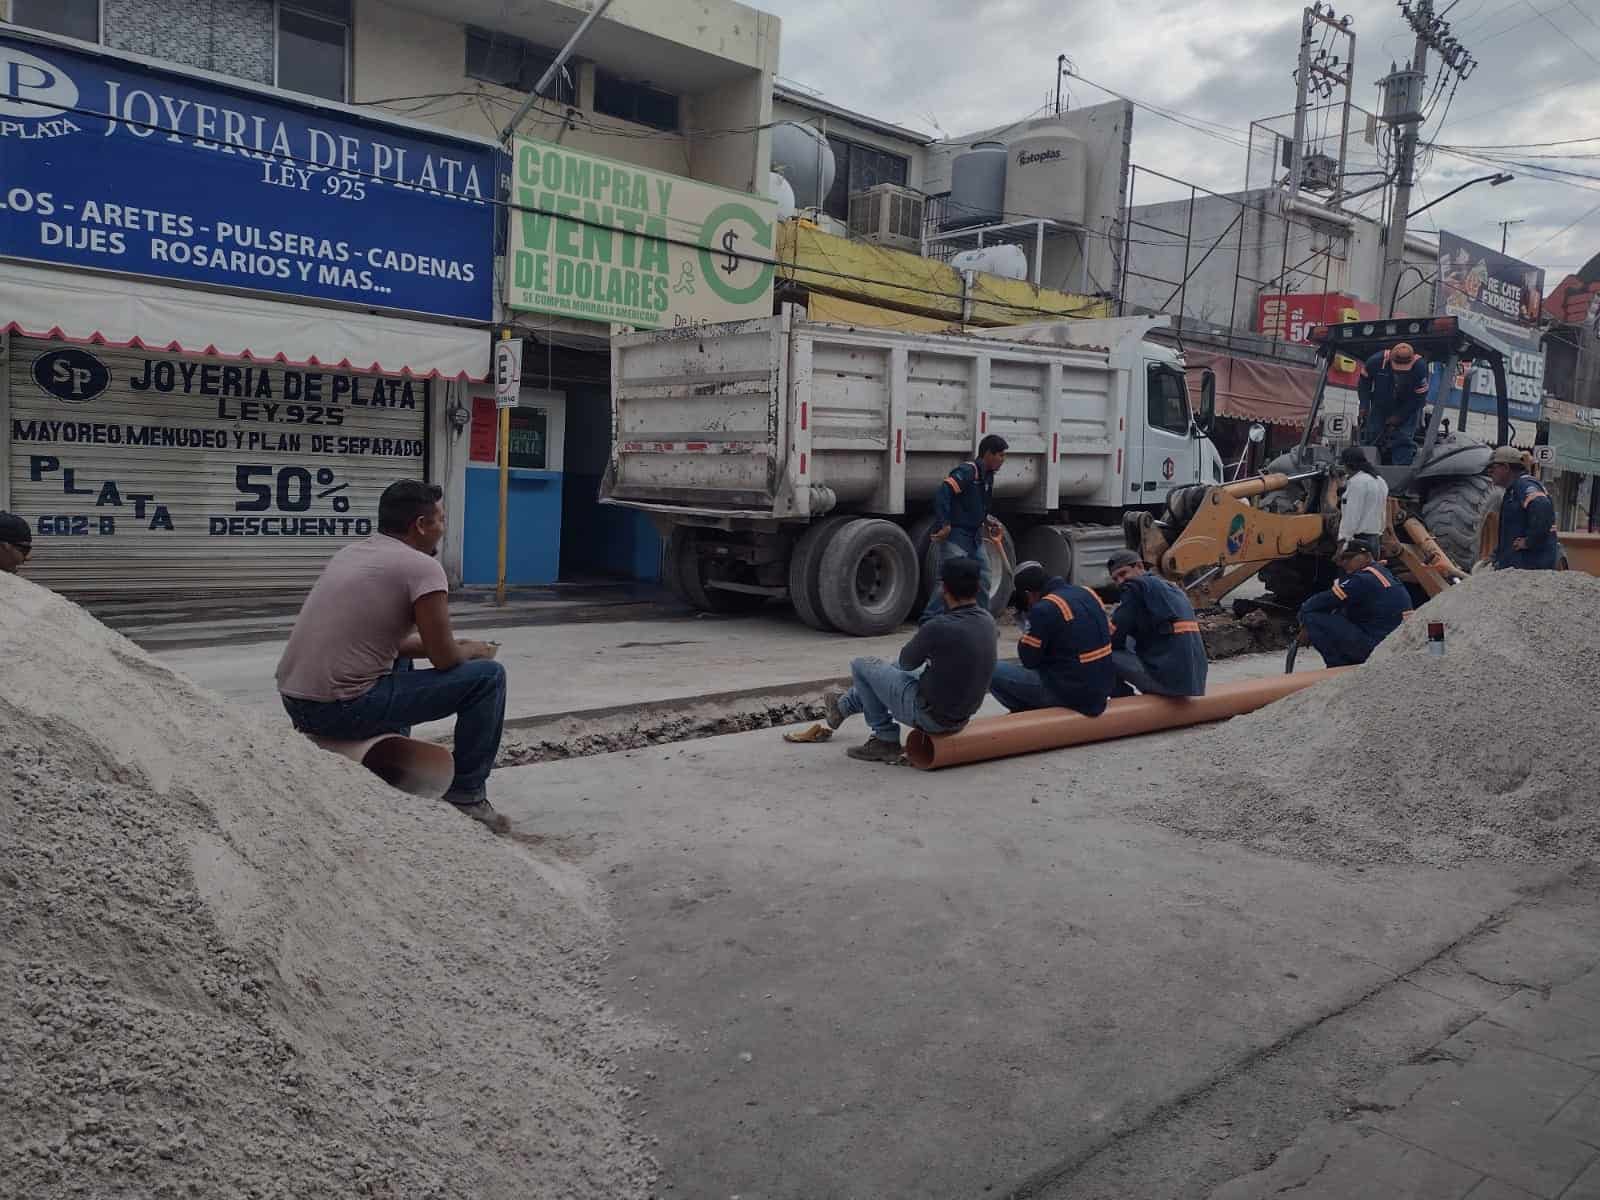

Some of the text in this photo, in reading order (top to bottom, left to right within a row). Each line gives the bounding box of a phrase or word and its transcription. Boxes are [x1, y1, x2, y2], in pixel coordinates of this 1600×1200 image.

[1, 118, 82, 139] PLATA
[103, 80, 486, 205] JOYERIA DE PLATA
[261, 162, 366, 201] LEY .925
[518, 146, 672, 216] COMPRA Y
[0, 188, 475, 282] OS ARETES PULSERAS CADENAS
[519, 187, 670, 274] VENTA
[40, 222, 392, 294] DIJES ROSARIOS Y MAS...
[515, 251, 668, 312] DE DOLARES
[131, 359, 416, 408] JOYERIA DE PLATA
[498, 354, 507, 384] E
[127, 426, 227, 449] MENUDEO
[234, 430, 243, 449] Y
[248, 431, 300, 452] PLAN
[311, 436, 336, 453] DE
[338, 437, 423, 457] SEPARADO
[1333, 418, 1344, 431] E
[1540, 449, 1549, 459] E
[30, 456, 174, 531] PLATA
[235, 465, 350, 513] 50%
[209, 517, 372, 536] DESCUENTO
